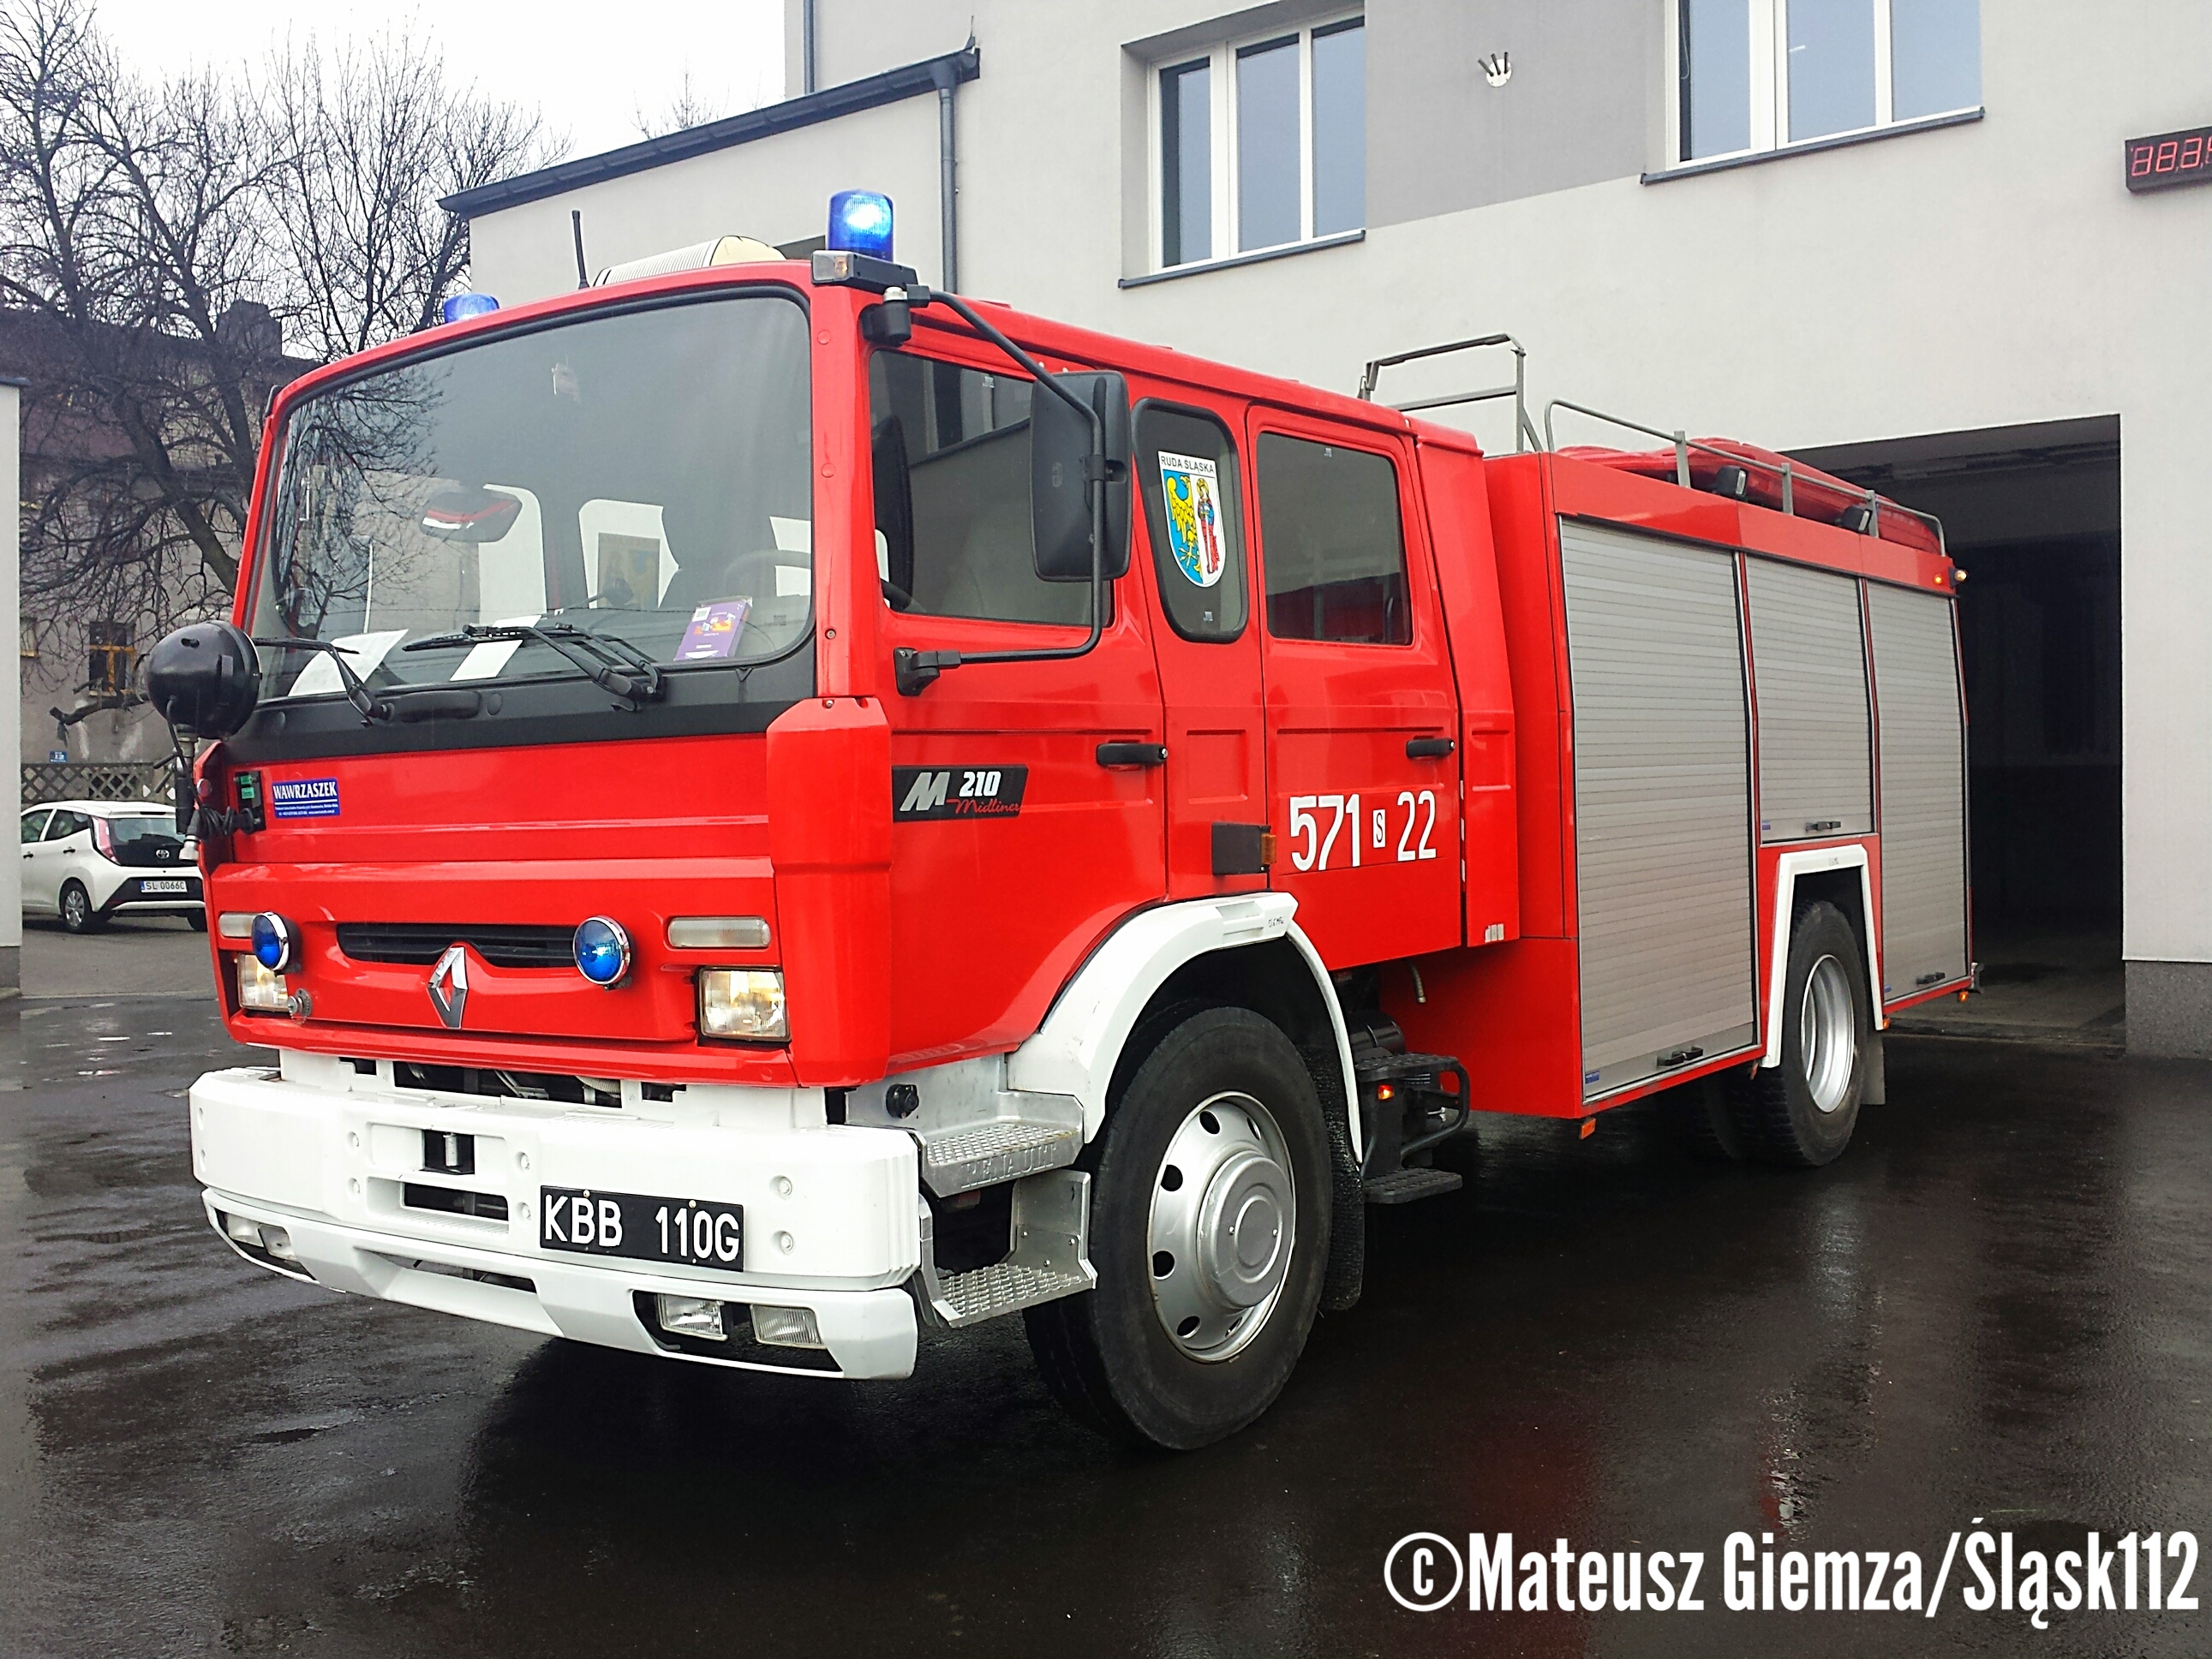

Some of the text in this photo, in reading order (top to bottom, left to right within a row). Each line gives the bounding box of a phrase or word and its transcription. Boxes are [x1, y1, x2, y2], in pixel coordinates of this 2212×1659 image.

[1161, 456, 1214, 474] RUDA ŚLĄSKA
[272, 781, 338, 800] WAWRZASZEK
[900, 771, 1001, 811] M 210
[946, 797, 1020, 815] Midliner
[1289, 793, 1360, 872] 571
[1396, 790, 1437, 862] 22
[145, 881, 158, 890] SL
[960, 1142, 1057, 1189] RENAULT
[544, 1193, 740, 1262] KBB 110G
